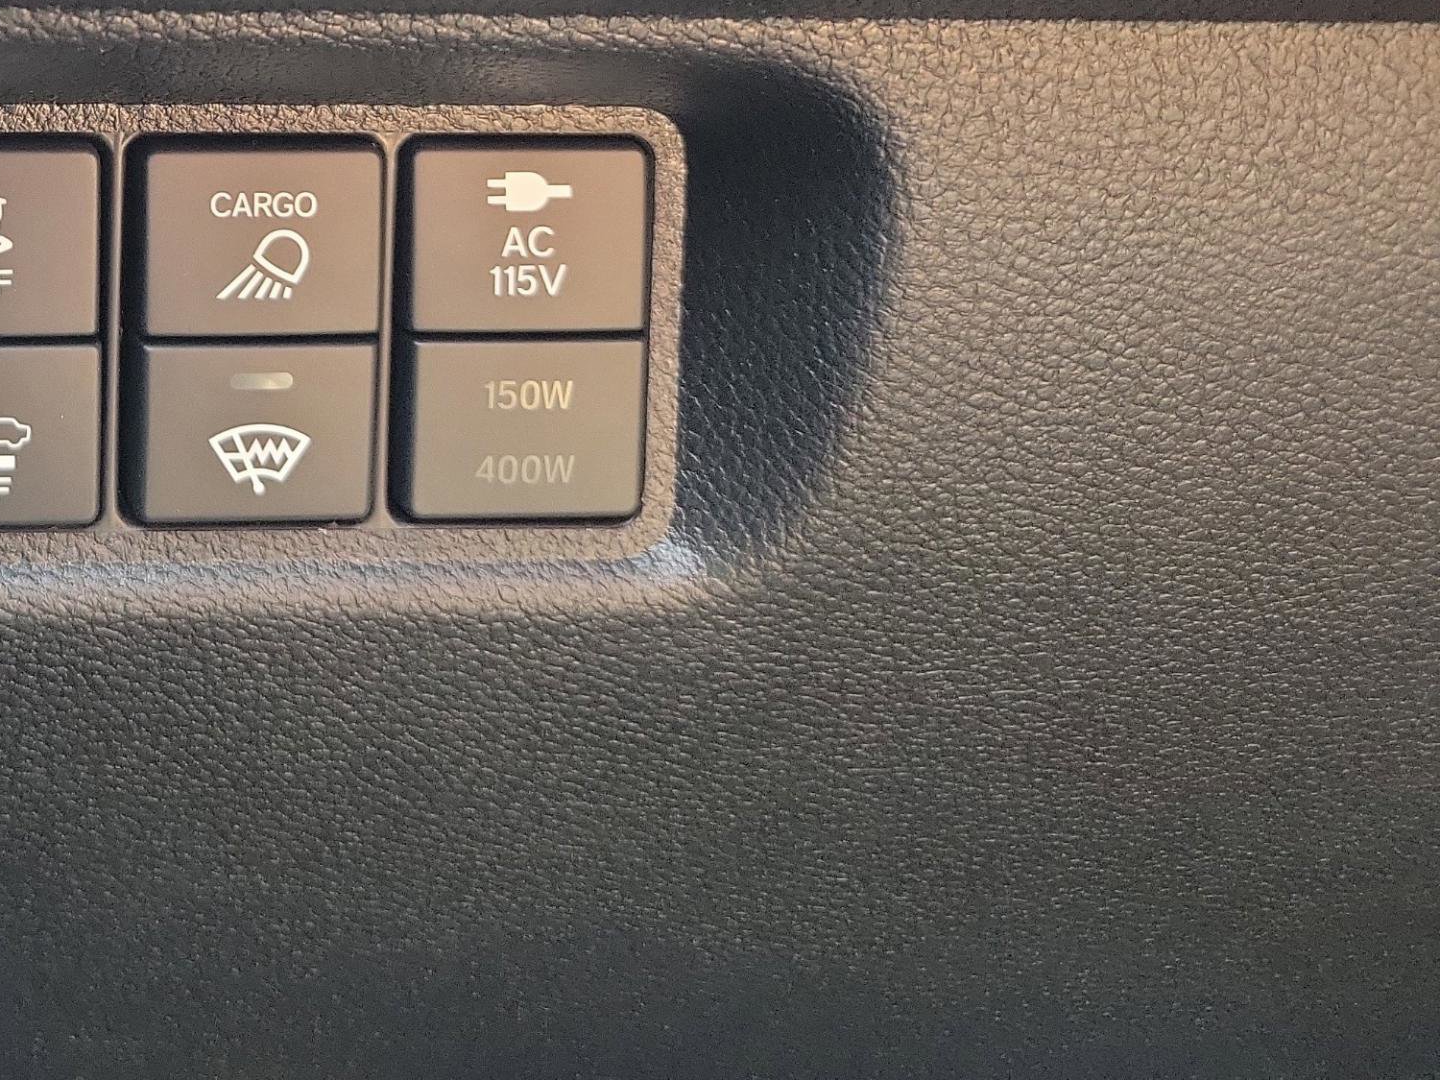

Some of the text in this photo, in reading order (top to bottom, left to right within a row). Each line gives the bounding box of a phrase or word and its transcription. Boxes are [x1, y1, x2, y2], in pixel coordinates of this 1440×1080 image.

[209, 190, 319, 219] CARGO
[500, 225, 557, 258] AC
[488, 263, 568, 298] 115V
[483, 379, 574, 411] 150W
[475, 453, 576, 485] 400W
